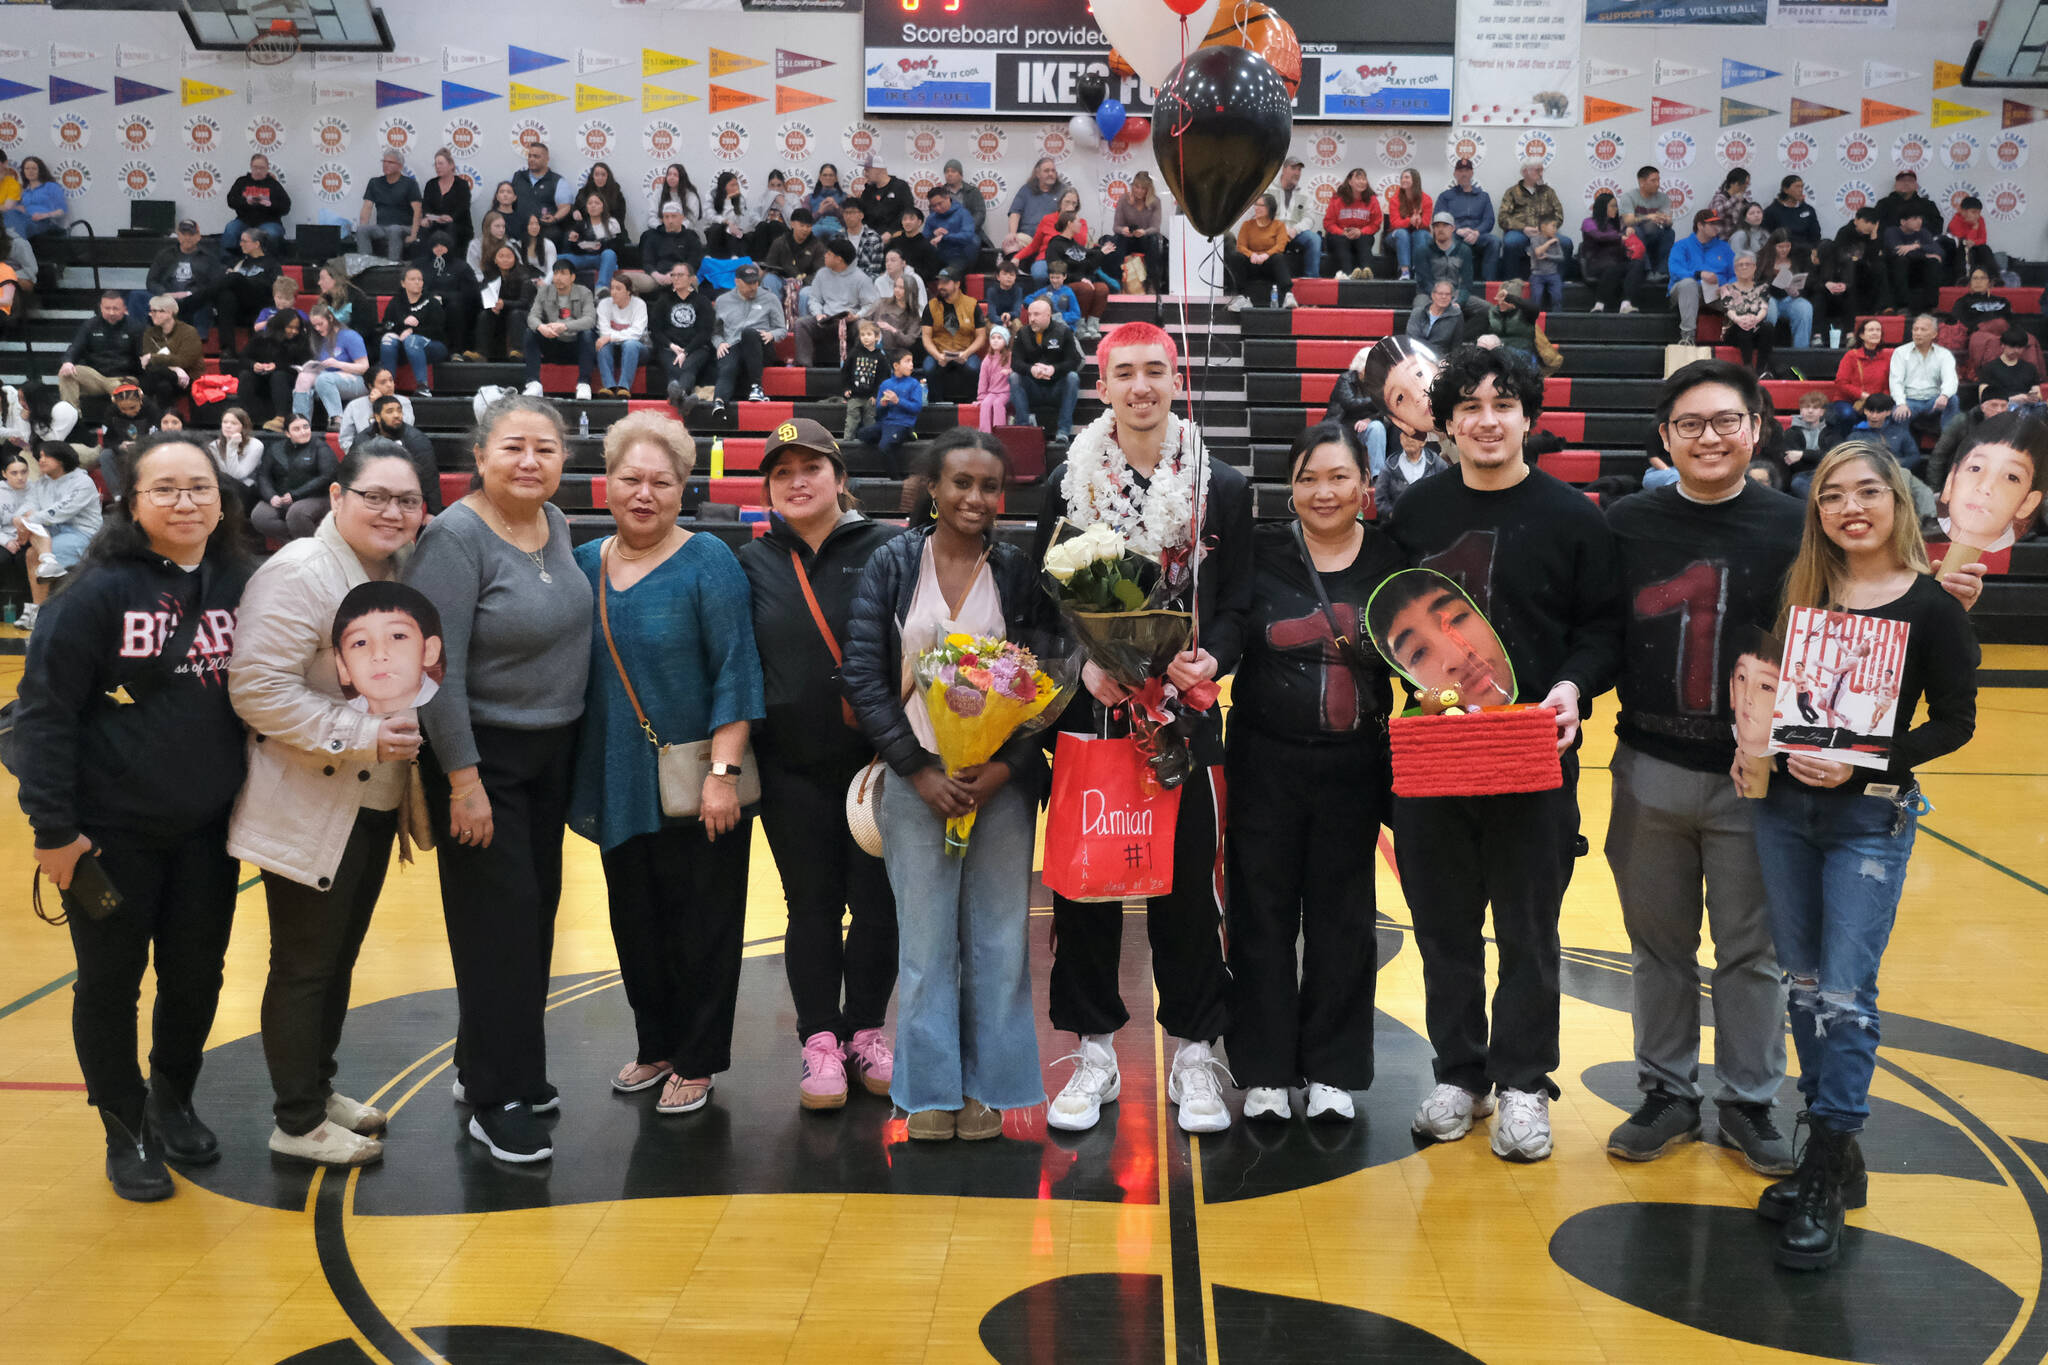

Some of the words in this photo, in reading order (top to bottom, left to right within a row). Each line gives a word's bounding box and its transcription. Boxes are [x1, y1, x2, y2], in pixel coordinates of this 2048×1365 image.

[1598, 11, 1654, 20] SUPPORTS
[1659, 8, 1685, 18] JDHS
[1690, 5, 1757, 16] VOLLEYBALL
[1778, 8, 1822, 16] PRINT
[1840, 7, 1888, 16] MEDIA
[902, 23, 1018, 43] Scoreboard
[393, 117, 416, 134] CHAMP
[459, 118, 482, 136] CHAMP
[525, 119, 548, 136] CHAMP
[594, 121, 616, 138] CHAMP
[658, 121, 682, 138] CHAMP
[725, 121, 748, 138] CHAMP
[791, 121, 814, 139] CHAMP
[858, 121, 881, 139] CHAMP
[985, 123, 1008, 140] CHAMP
[1462, 130, 1484, 148] CHAMP
[1532, 130, 1555, 148] CHAMP
[1602, 130, 1625, 147] CHAMP
[1672, 131, 1696, 148] CHAMP
[1734, 132, 1756, 150] CHAMP
[1795, 132, 1818, 149] CHAMP
[582, 148, 612, 160] JUNEAU
[647, 148, 677, 160] JUNEAU
[714, 148, 744, 160] JUNEAU
[780, 148, 810, 160] JUNEAU
[910, 150, 940, 163] JUNEAU
[973, 150, 1003, 162] JUNEAU
[1588, 154, 1623, 167] KETCHIKAN
[1082, 788, 1152, 835] Damian
[1124, 842, 1152, 869] #1
